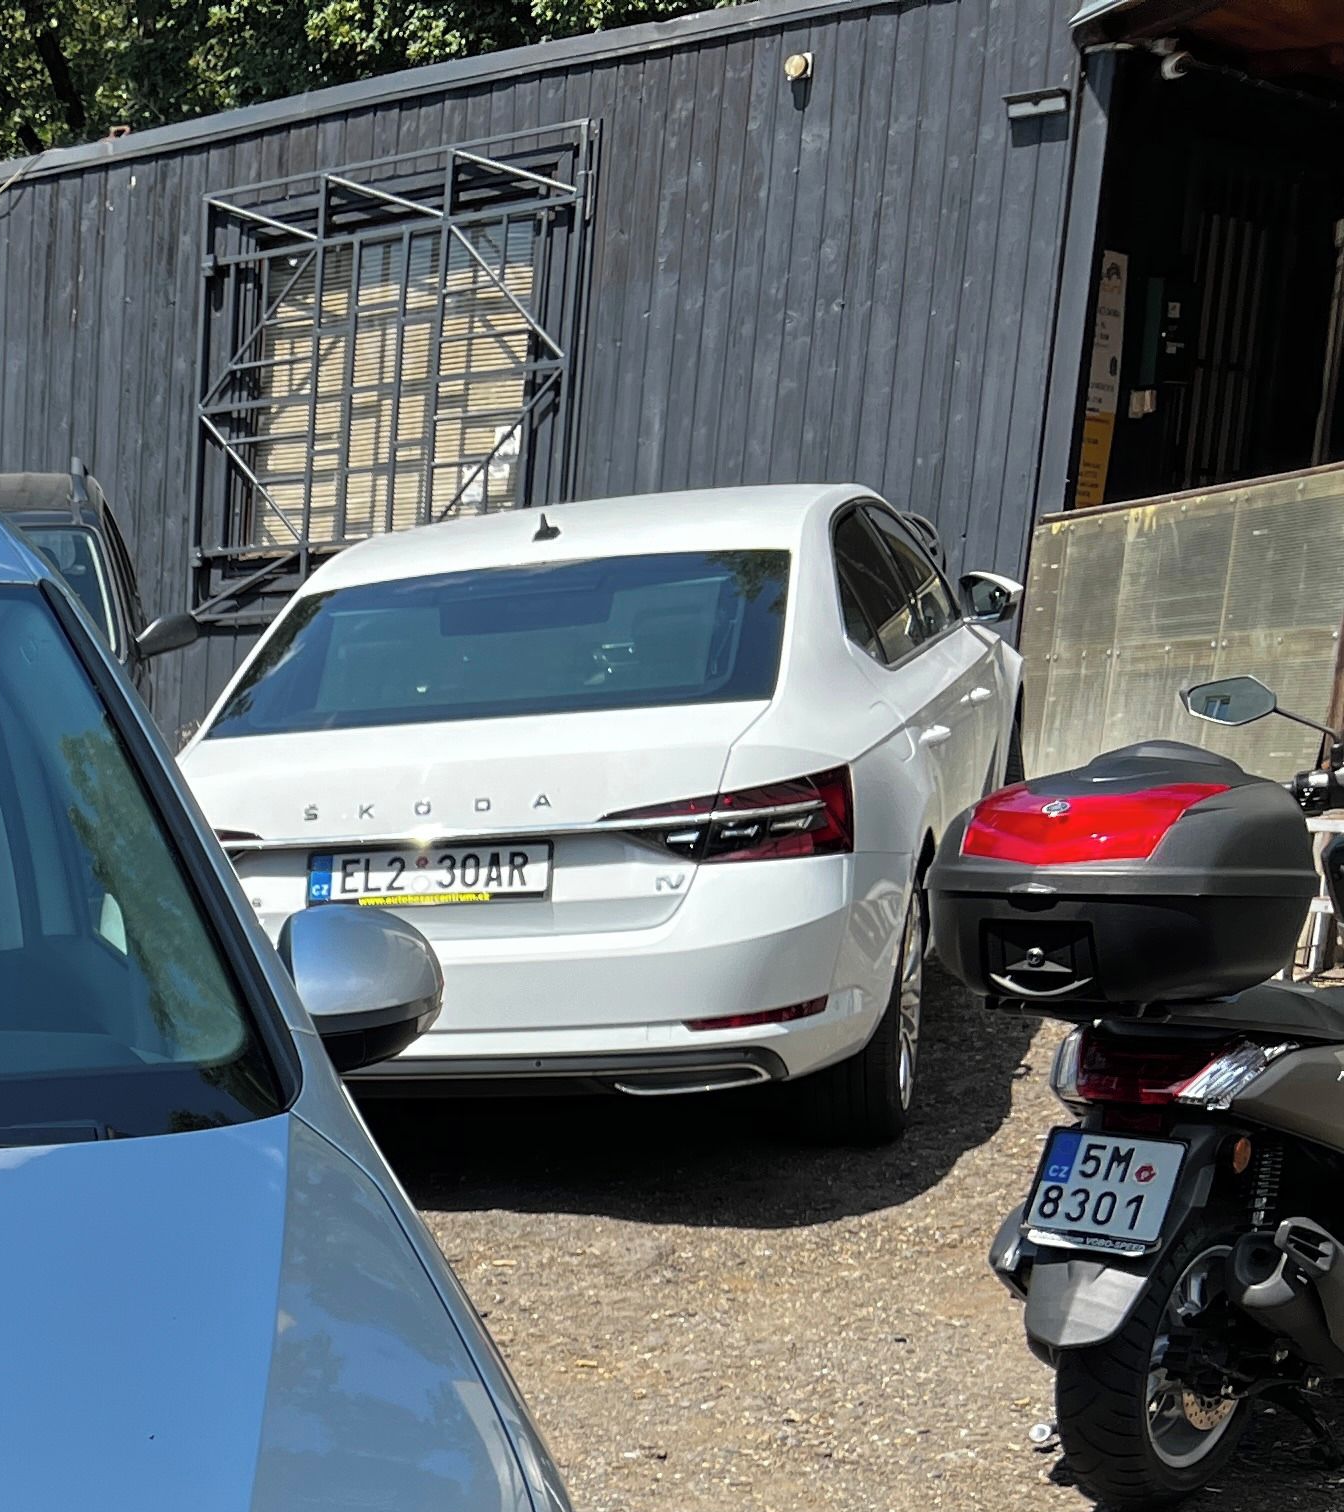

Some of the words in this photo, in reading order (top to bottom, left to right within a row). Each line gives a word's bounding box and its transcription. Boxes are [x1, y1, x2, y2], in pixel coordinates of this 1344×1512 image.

[312, 883, 328, 897] CZ
[340, 856, 406, 894] EL2
[436, 851, 530, 889] 30AR
[1048, 1165, 1070, 1178] CZ
[1078, 1143, 1136, 1184] 5M
[1038, 1185, 1146, 1231] 8301
